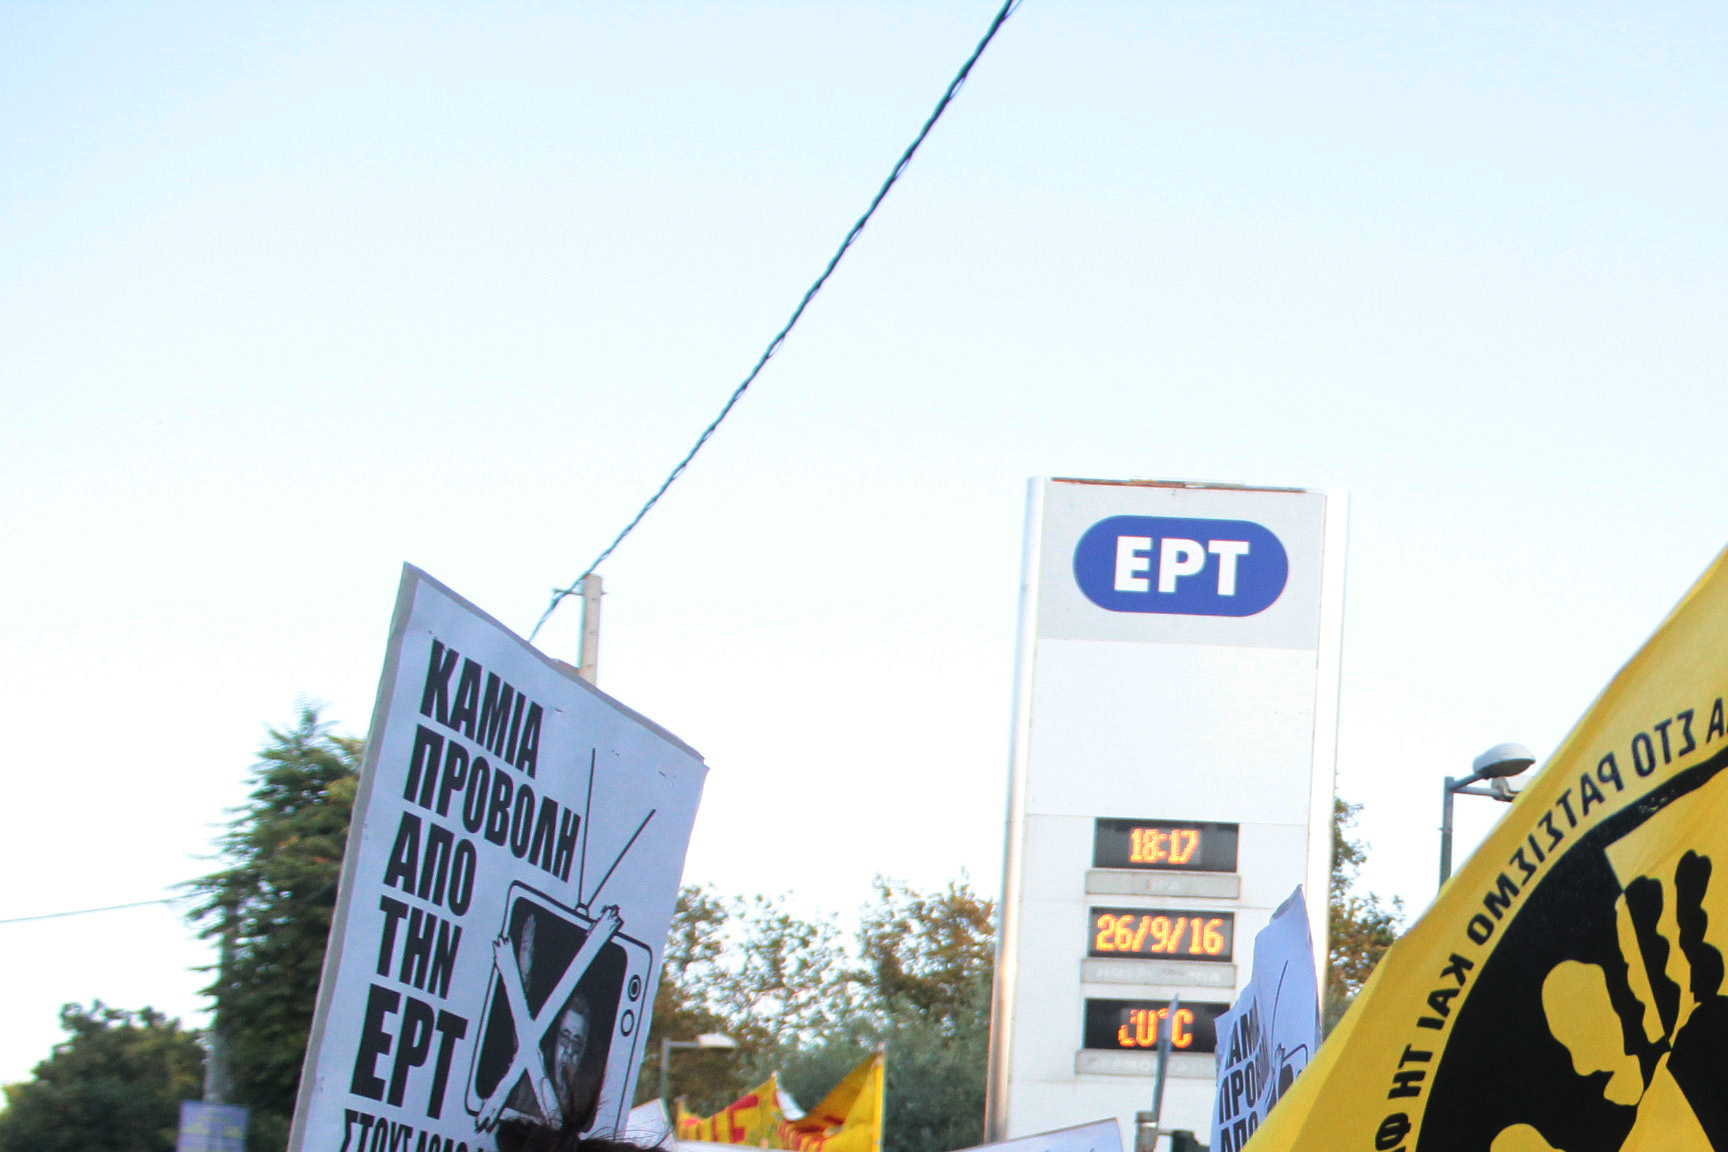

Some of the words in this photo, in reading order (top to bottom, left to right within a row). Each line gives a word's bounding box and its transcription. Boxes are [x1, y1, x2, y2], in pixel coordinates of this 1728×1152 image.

[1114, 535, 1250, 596] ΕΡΤ
[419, 637, 544, 779] ΚΑΜΙΑ
[403, 722, 582, 883] ΠΡΟΒΟΛΗ
[1130, 827, 1199, 864] 18:17
[383, 810, 478, 918] ΑΠΟ
[375, 894, 463, 1000] ΤΗΝ
[1096, 913, 1225, 956] 26/9/16
[349, 982, 470, 1121] ΕΡΤ
